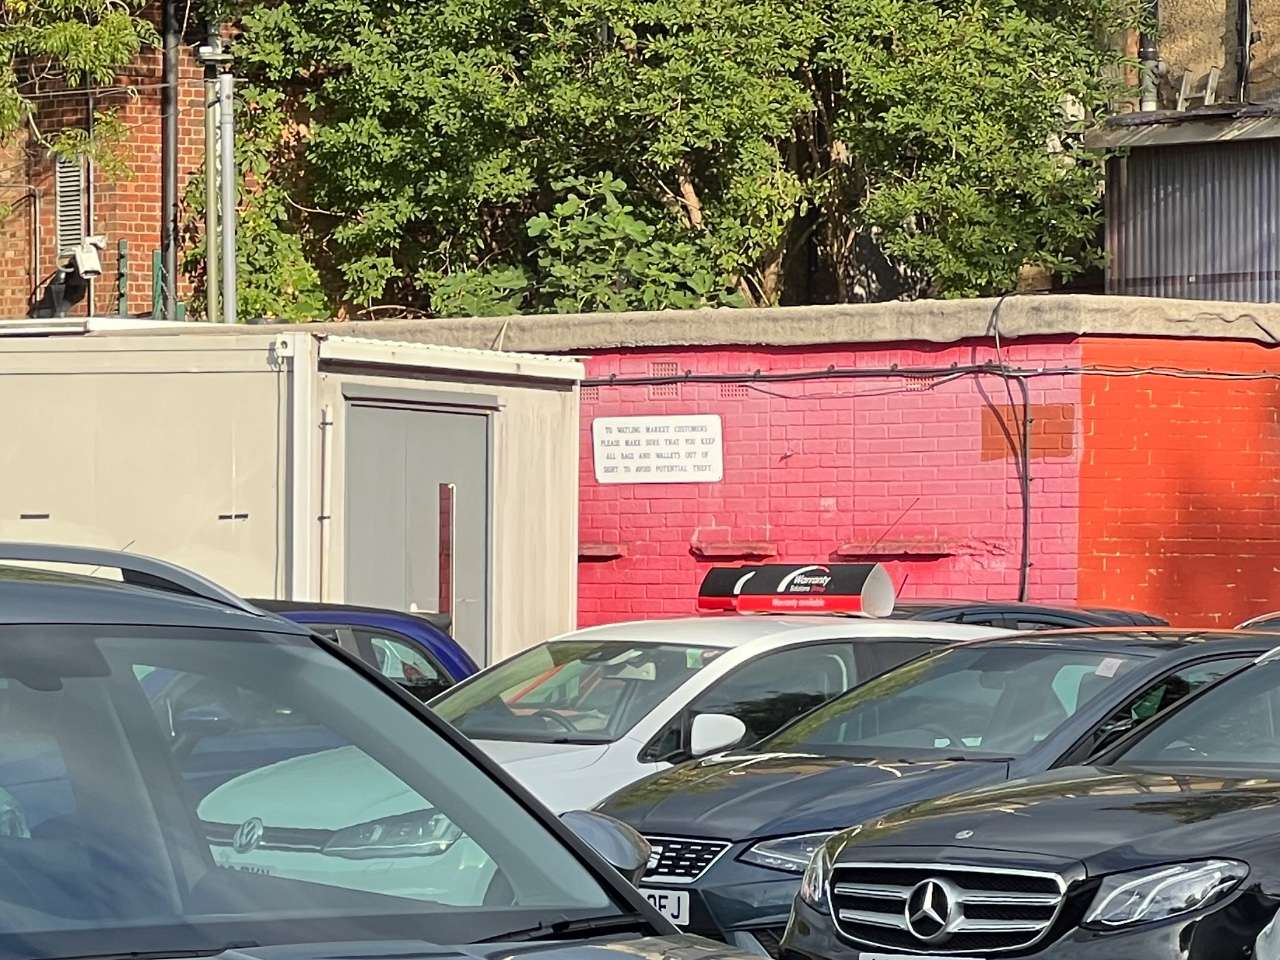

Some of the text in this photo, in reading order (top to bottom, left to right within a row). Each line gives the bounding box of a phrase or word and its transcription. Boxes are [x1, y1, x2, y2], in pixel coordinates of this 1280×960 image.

[605, 426, 613, 434] TO
[674, 425, 708, 433] CUSTOMERS
[600, 439, 620, 447] PLEASE
[625, 439, 641, 447] MAKE
[685, 438, 696, 446] YOU
[701, 438, 716, 446] KEEP
[606, 452, 616, 460] ALL
[621, 452, 634, 460] BAGS
[685, 451, 697, 459] OUT
[701, 451, 709, 459] OF
[655, 465, 688, 473] POTENTIAL
[793, 575, 832, 587] Warranty
